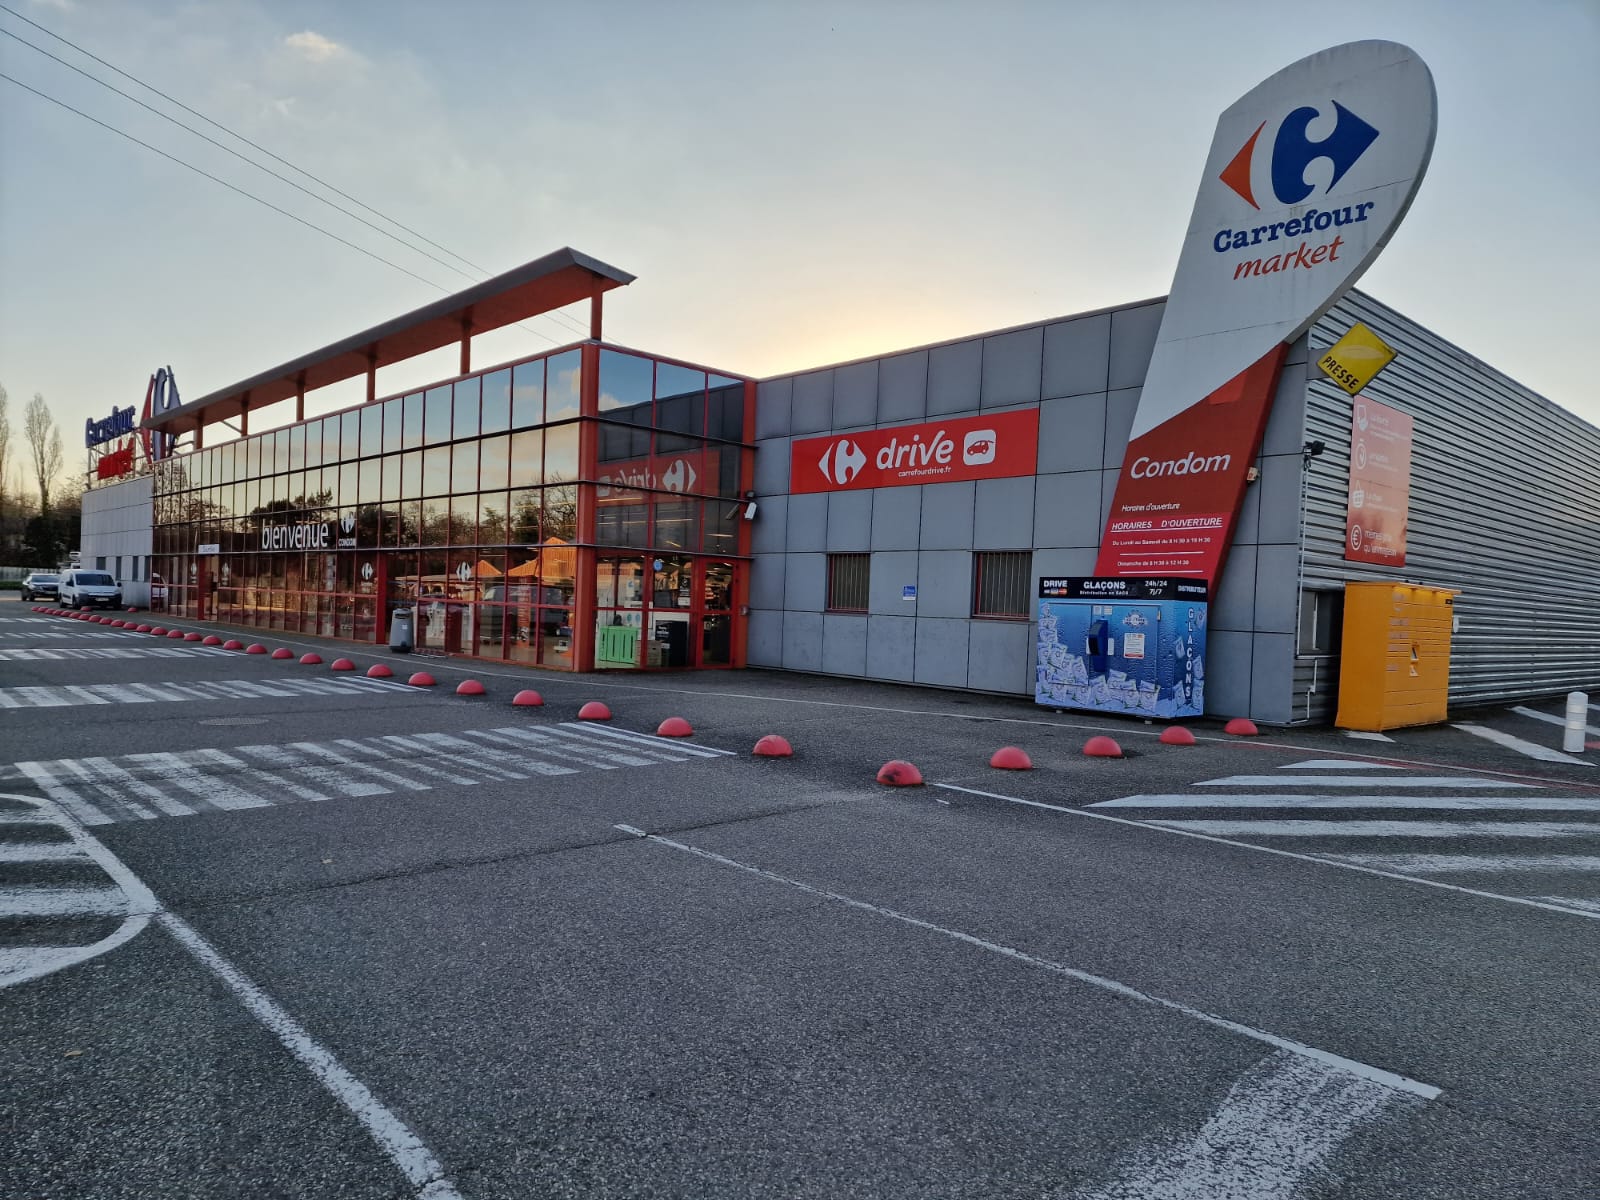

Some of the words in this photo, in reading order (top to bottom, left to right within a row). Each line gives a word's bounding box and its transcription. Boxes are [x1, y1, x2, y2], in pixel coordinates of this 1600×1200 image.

[1213, 201, 1374, 253] Carrefour
[1233, 235, 1344, 280] market
[1321, 355, 1360, 390] PRESSE
[876, 430, 954, 471] drive
[1130, 451, 1231, 479] Condom
[898, 465, 952, 478] carrefourdrive.fr
[261, 518, 329, 550] bienvenue
[1112, 521, 1152, 530] HORAIRES
[1161, 517, 1222, 527] D'OUVERTURE
[1043, 580, 1068, 588] DRIVE
[1083, 581, 1126, 591] GLAÇONS
